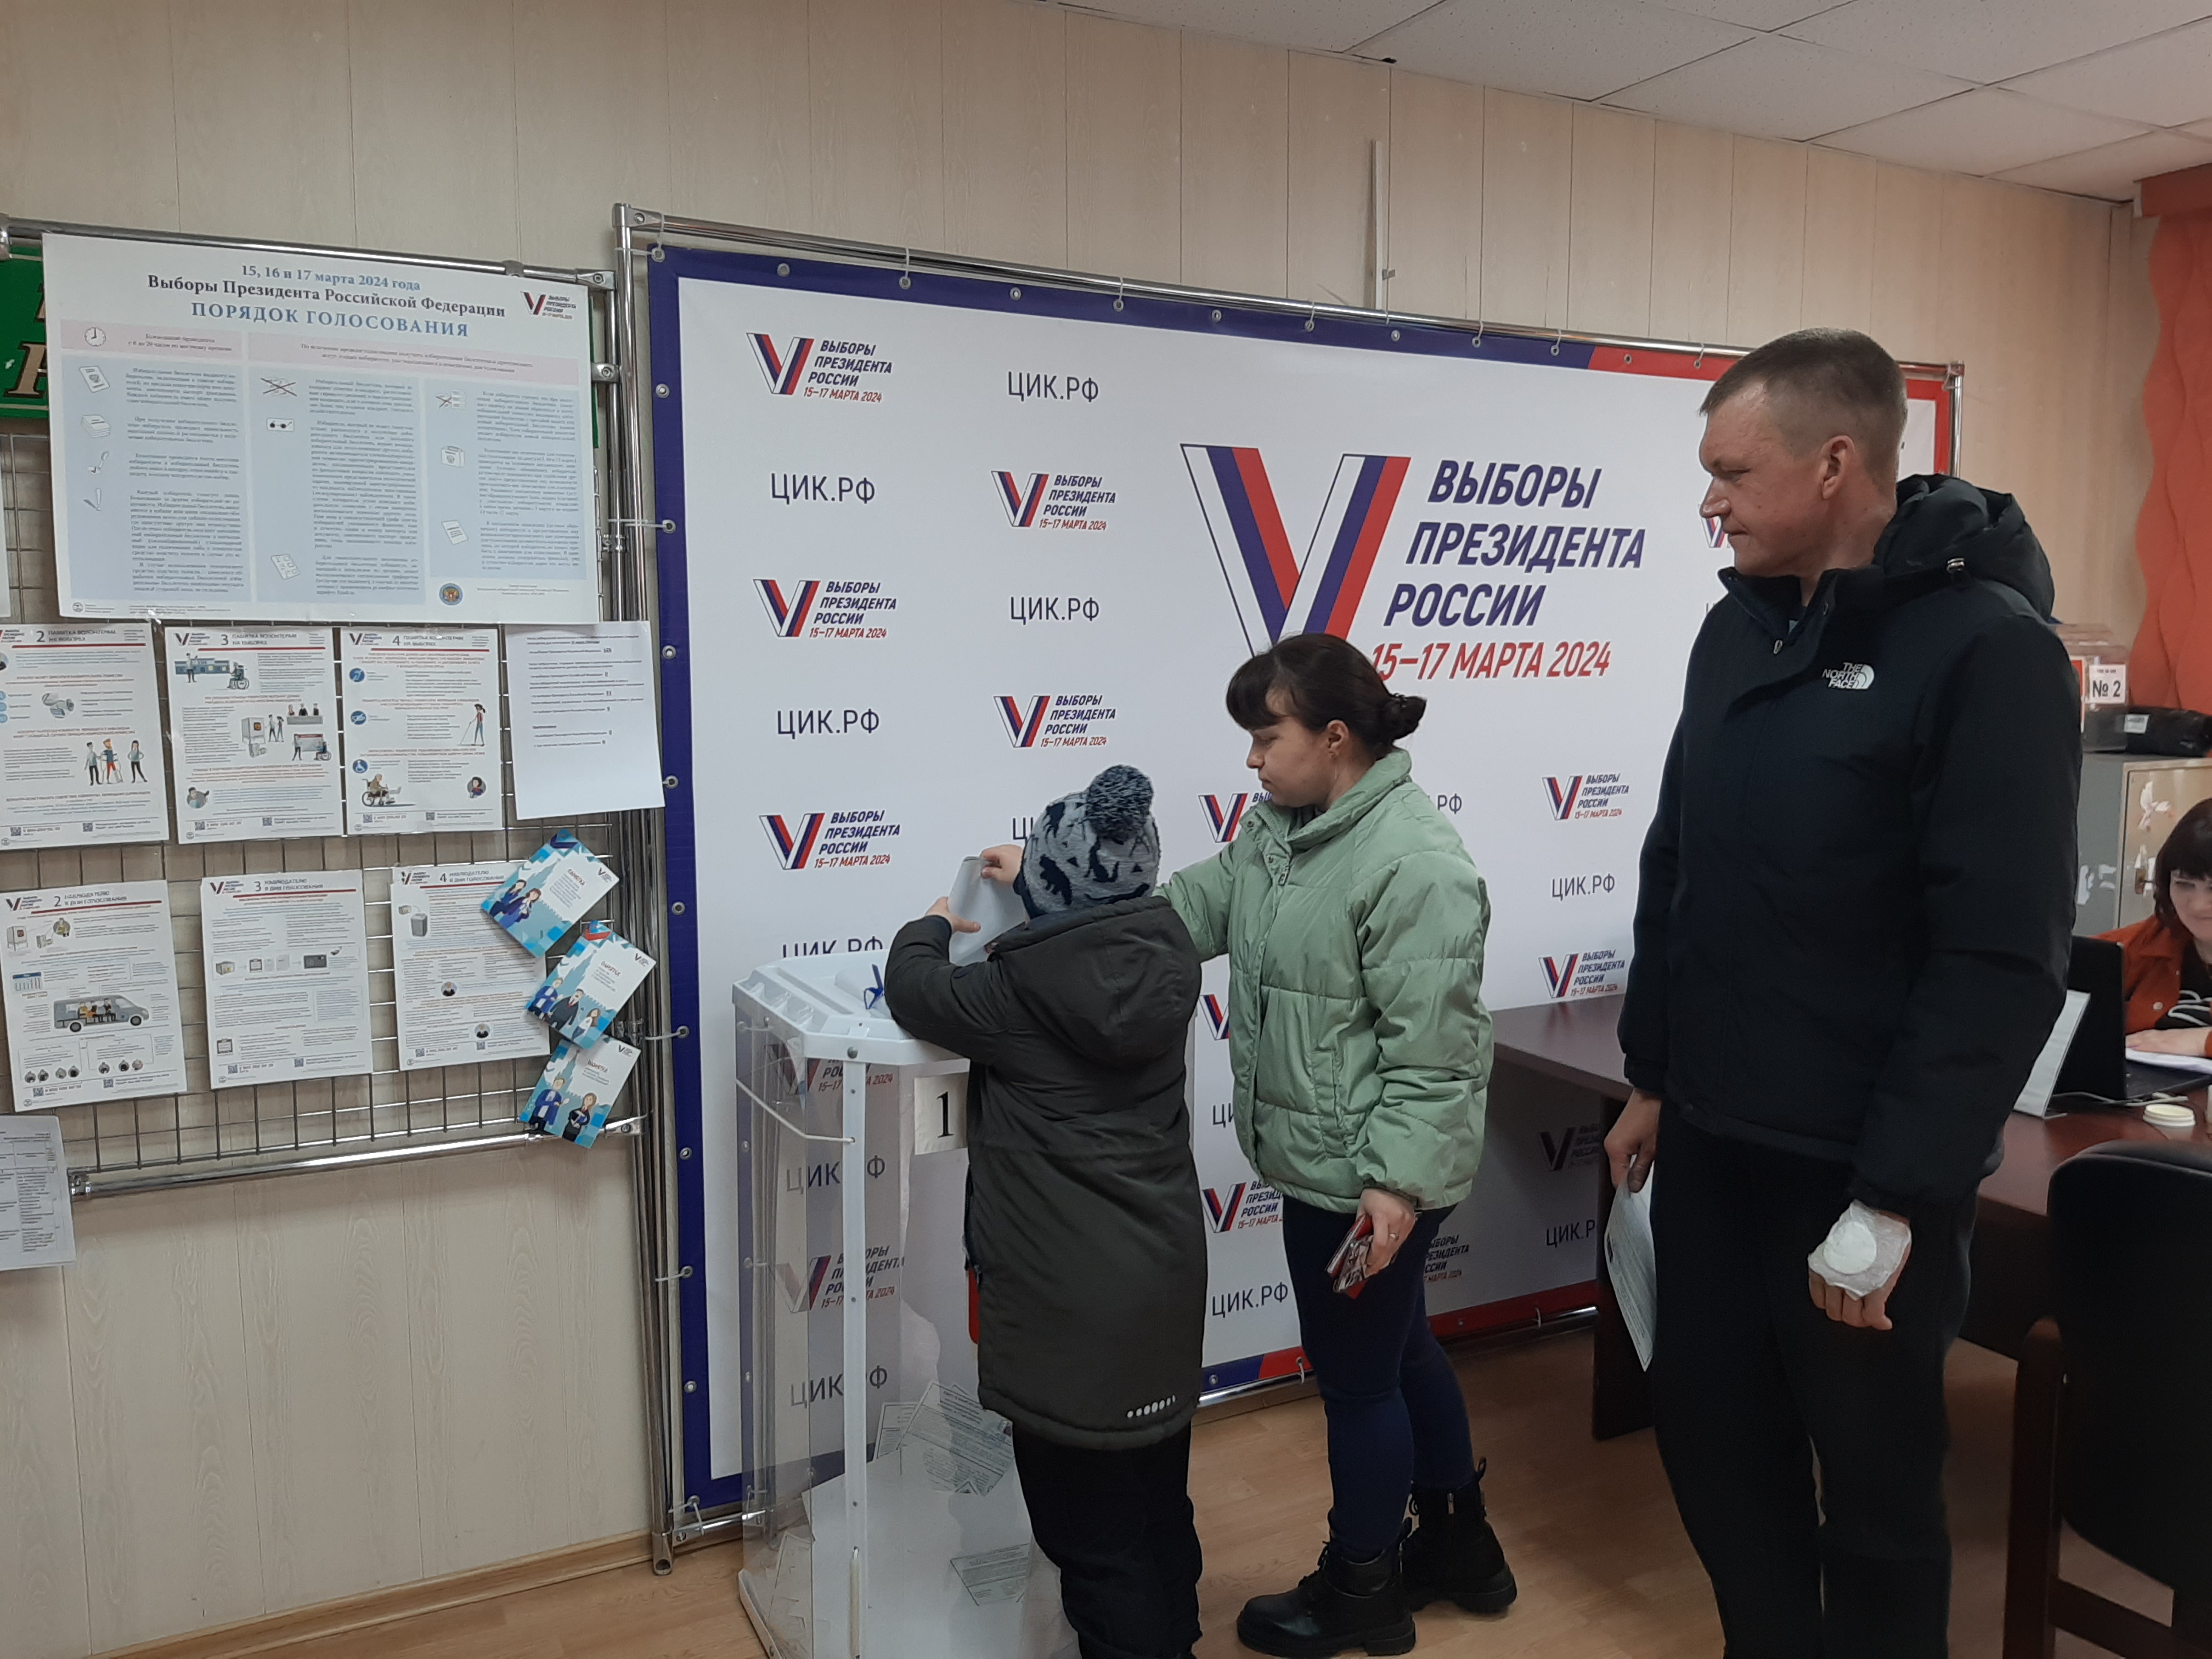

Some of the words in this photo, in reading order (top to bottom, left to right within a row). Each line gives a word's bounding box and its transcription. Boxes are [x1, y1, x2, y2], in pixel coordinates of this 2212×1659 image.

[242, 266, 261, 278] 15,
[266, 267, 280, 278] 16
[297, 270, 313, 280] 17
[315, 273, 354, 286] марта
[359, 275, 388, 287] 2024
[392, 280, 420, 291] года
[148, 275, 218, 295] Выборы
[222, 280, 320, 300] Президента
[325, 289, 416, 308] Российской
[421, 297, 505, 317] Федерации
[191, 302, 298, 323] ПОРЯДОК
[307, 311, 469, 337] ГОЛОСОВАНИЯ
[820, 341, 876, 356] ВЫБОРЫ
[815, 356, 891, 373] ПРЕЗИДЕНТА
[808, 371, 859, 386] РОССИИ
[1009, 371, 1098, 402] ЦИК.РФ
[804, 387, 829, 398] 15–17
[830, 389, 859, 400] МАРТА
[861, 392, 882, 402] 2024
[1054, 475, 1102, 487] ВЫБОРЫ
[1427, 460, 1602, 508] ВЫБОРЫ
[772, 473, 874, 505] ЦИК.РФ
[1049, 490, 1115, 504] ПРЕЗИДЕНТА
[1043, 505, 1087, 516] РОССИИ
[1040, 518, 1061, 528] 15–17
[1061, 520, 1087, 529] МАРТА
[1088, 521, 1106, 531] 2024
[1406, 522, 1645, 573] ПРЕЗИДЕНТА
[826, 582, 880, 593] ВЫБОРЫ
[820, 597, 896, 611] ПРЕЗИДЕНТА
[1384, 584, 1547, 627] РОССИИ
[1011, 597, 1099, 625] ЦИК.РФ
[814, 613, 864, 624] РОССИИ
[36, 631, 45, 642] 2
[810, 628, 834, 637] 15–17
[834, 628, 864, 637] МАРТА
[866, 628, 887, 638] 2024
[221, 634, 229, 646] 3
[392, 636, 400, 646] 4
[1373, 643, 1450, 681] 15–17
[1449, 642, 1544, 679] МАРТА
[1547, 641, 1611, 677] 2024
[1843, 662, 1863, 673] THE
[1822, 669, 1859, 680] NORTH
[1828, 679, 1857, 689] FACE
[2113, 680, 2121, 697] 2
[1056, 695, 1102, 706] ВЫБОРЫ
[1050, 709, 1115, 720] ПРЕЗИДЕНТА
[778, 709, 879, 739] ЦИК.РФ
[1045, 724, 1087, 735] РОССИИ
[1041, 738, 1062, 747] 15–17
[1062, 737, 1087, 746] МАРТА
[1090, 737, 1106, 746] 2024
[1586, 774, 1620, 784] ВЫБОРЫ
[1582, 785, 1629, 796] ПРЕЗИДЕНТА
[1577, 798, 1609, 808] РОССИИ
[831, 810, 884, 823] ВЫБОРЫ
[825, 825, 900, 839] ПРЕЗИДЕНТА
[819, 842, 868, 855] РОССИИ
[815, 857, 839, 868] 15–17
[839, 855, 868, 867] МАРТА
[870, 854, 890, 865] 2024
[439, 873, 447, 883] 4
[253, 882, 262, 892] 3
[1553, 874, 1615, 901] ЦИК.РФ
[54, 896, 62, 907] 2
[1582, 950, 1616, 962] ВЫБОРЫ
[1578, 961, 1624, 973] ПРЕЗИДЕНТА
[1574, 974, 1605, 985] РОССИИ
[873, 1073, 893, 1085] 2024
[936, 1091, 954, 1138] 1
[787, 1155, 885, 1195] ЦИКФ
[1246, 1189, 1282, 1204] ПРЕЗИД
[1241, 1203, 1278, 1217] РОССИИ
[837, 1245, 890, 1264] ВОРЫ
[831, 1257, 905, 1279] ПИДЕНТА
[1425, 1261, 1447, 1273] ССИИ
[1212, 1282, 1288, 1318] ЦИК.РФ
[791, 1365, 888, 1409] ЦИКФ
